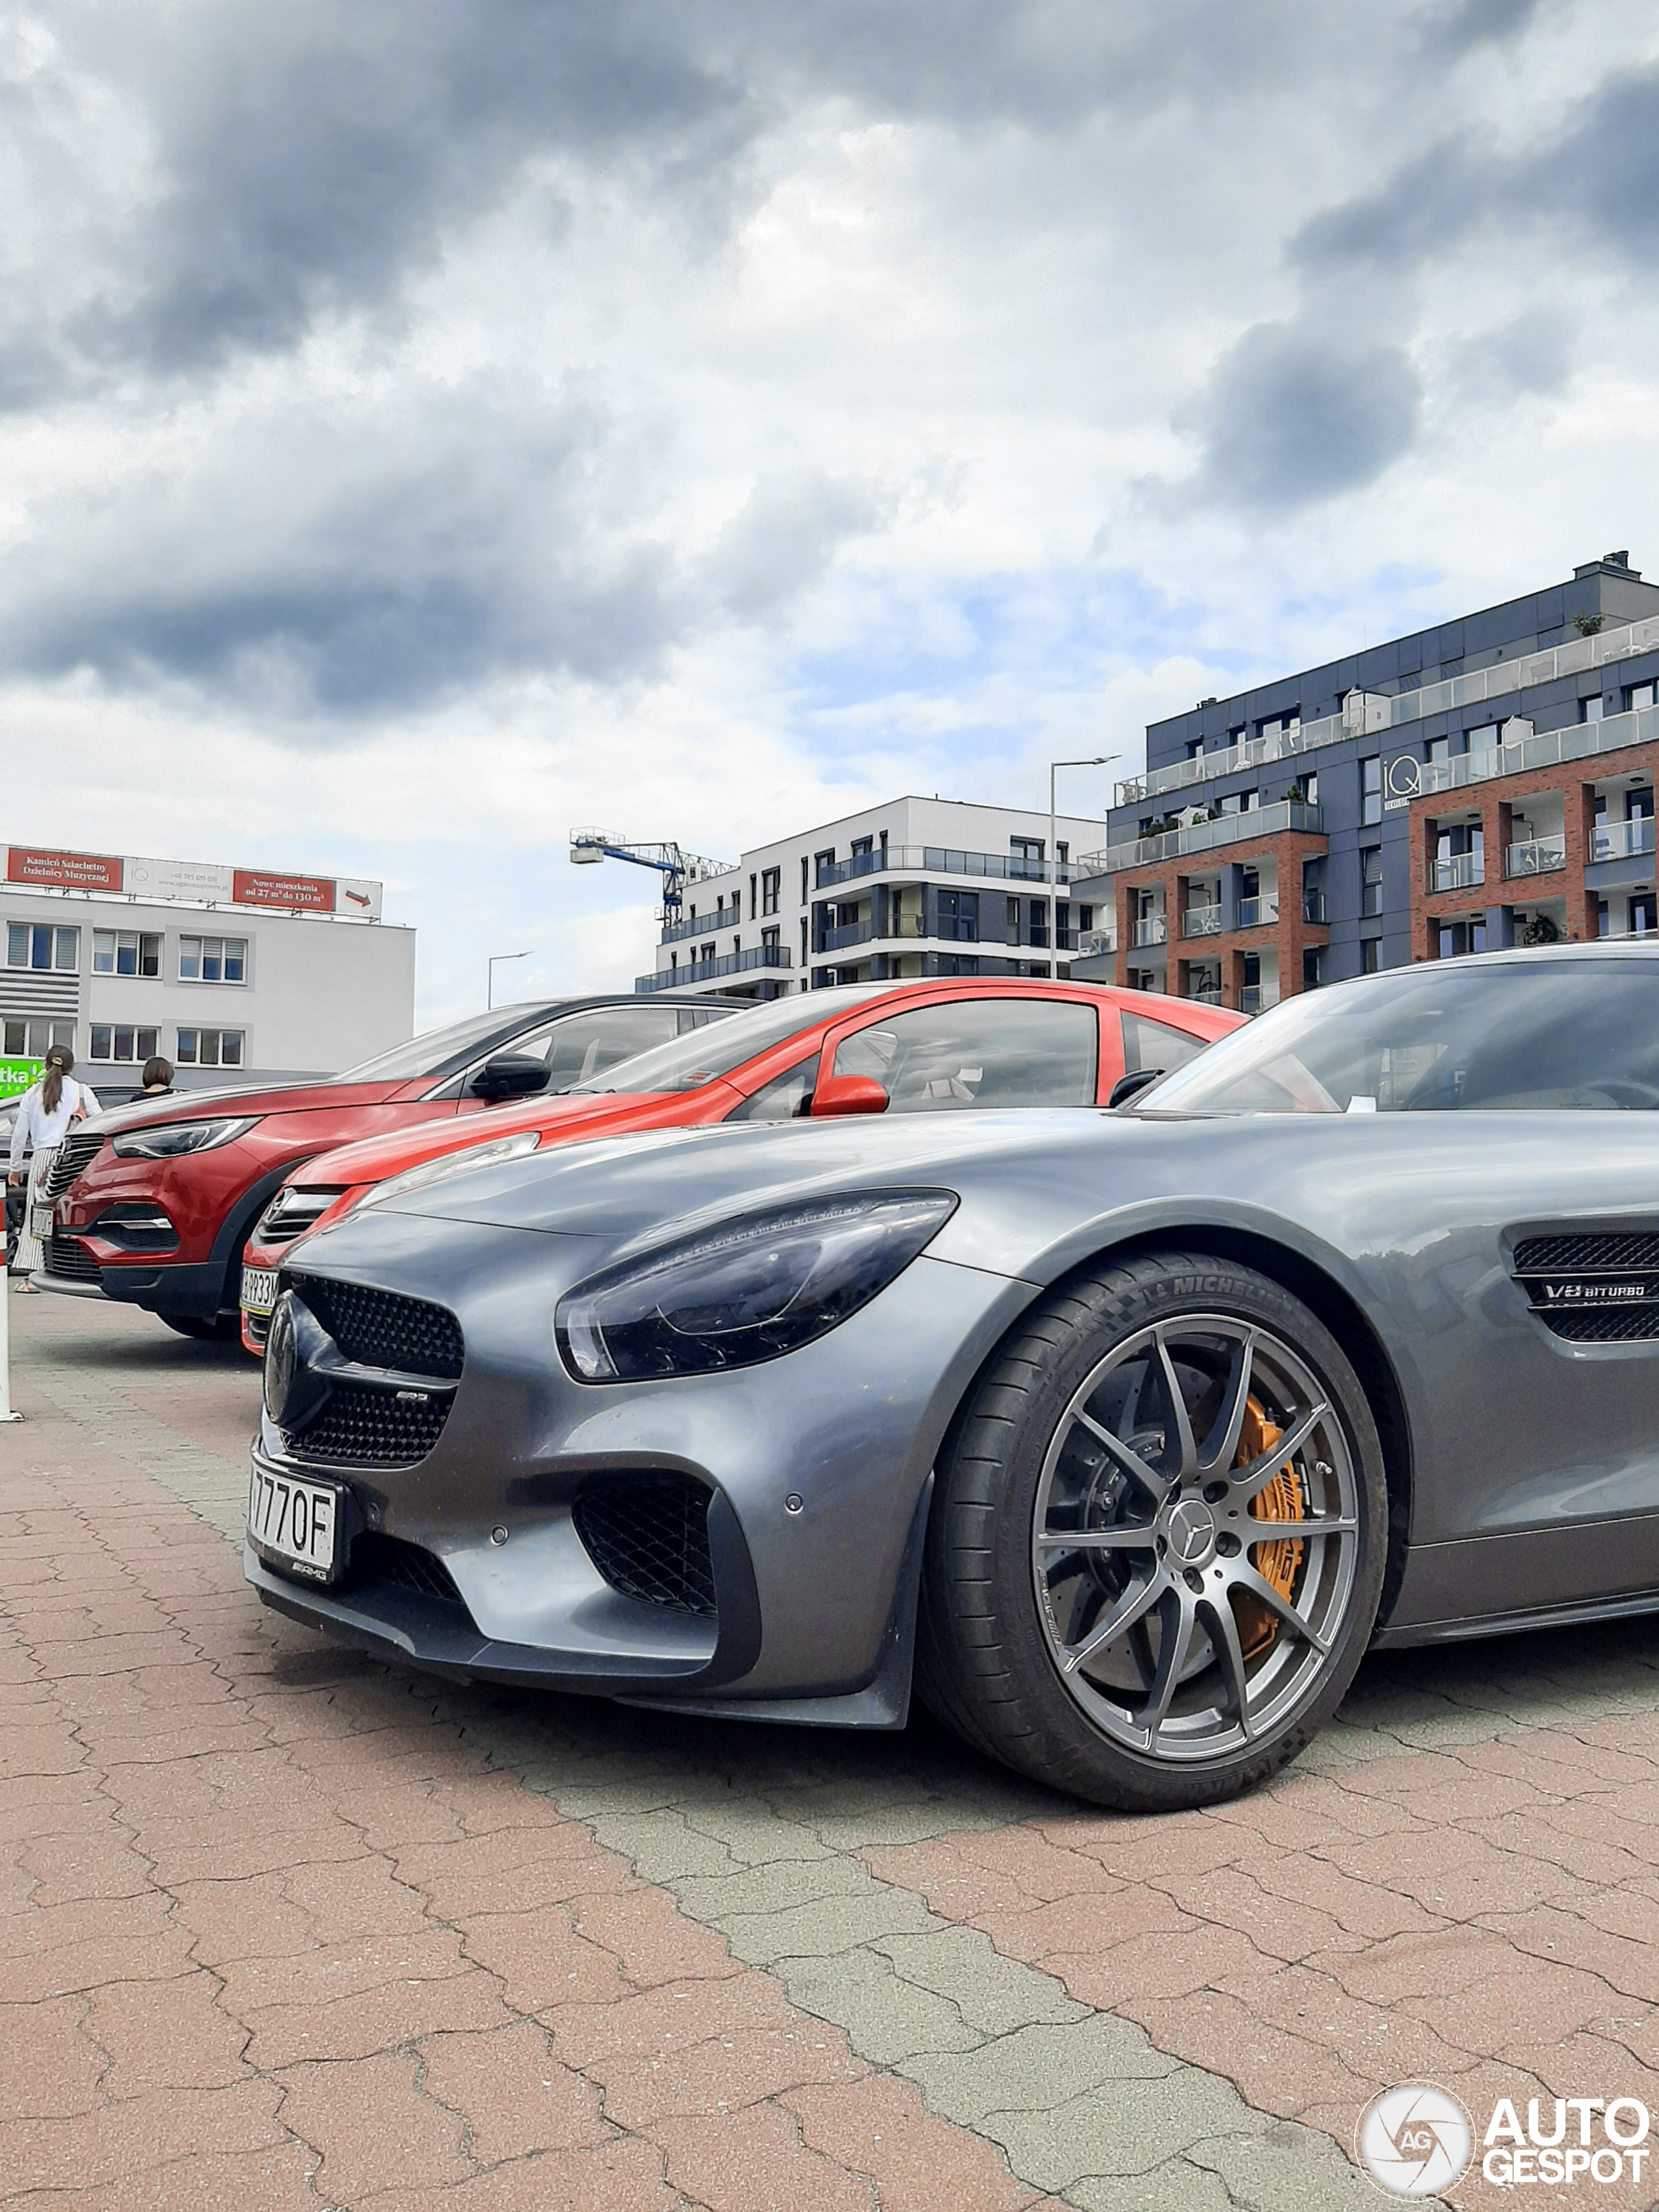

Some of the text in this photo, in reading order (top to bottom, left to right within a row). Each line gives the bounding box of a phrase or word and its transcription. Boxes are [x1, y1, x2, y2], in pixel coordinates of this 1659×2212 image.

[26, 856, 106, 872] Kamień Szlachetny
[23, 866, 109, 883] Dzielnicy Muzycznej
[252, 879, 318, 892] Nowe mieszkania
[258, 889, 269, 898] 27
[295, 893, 312, 902] 130
[1174, 1275, 1283, 1309] MICHELIN
[1545, 1284, 1645, 1298] V8 BITURBO
[302, 1566, 327, 1580] AMG
